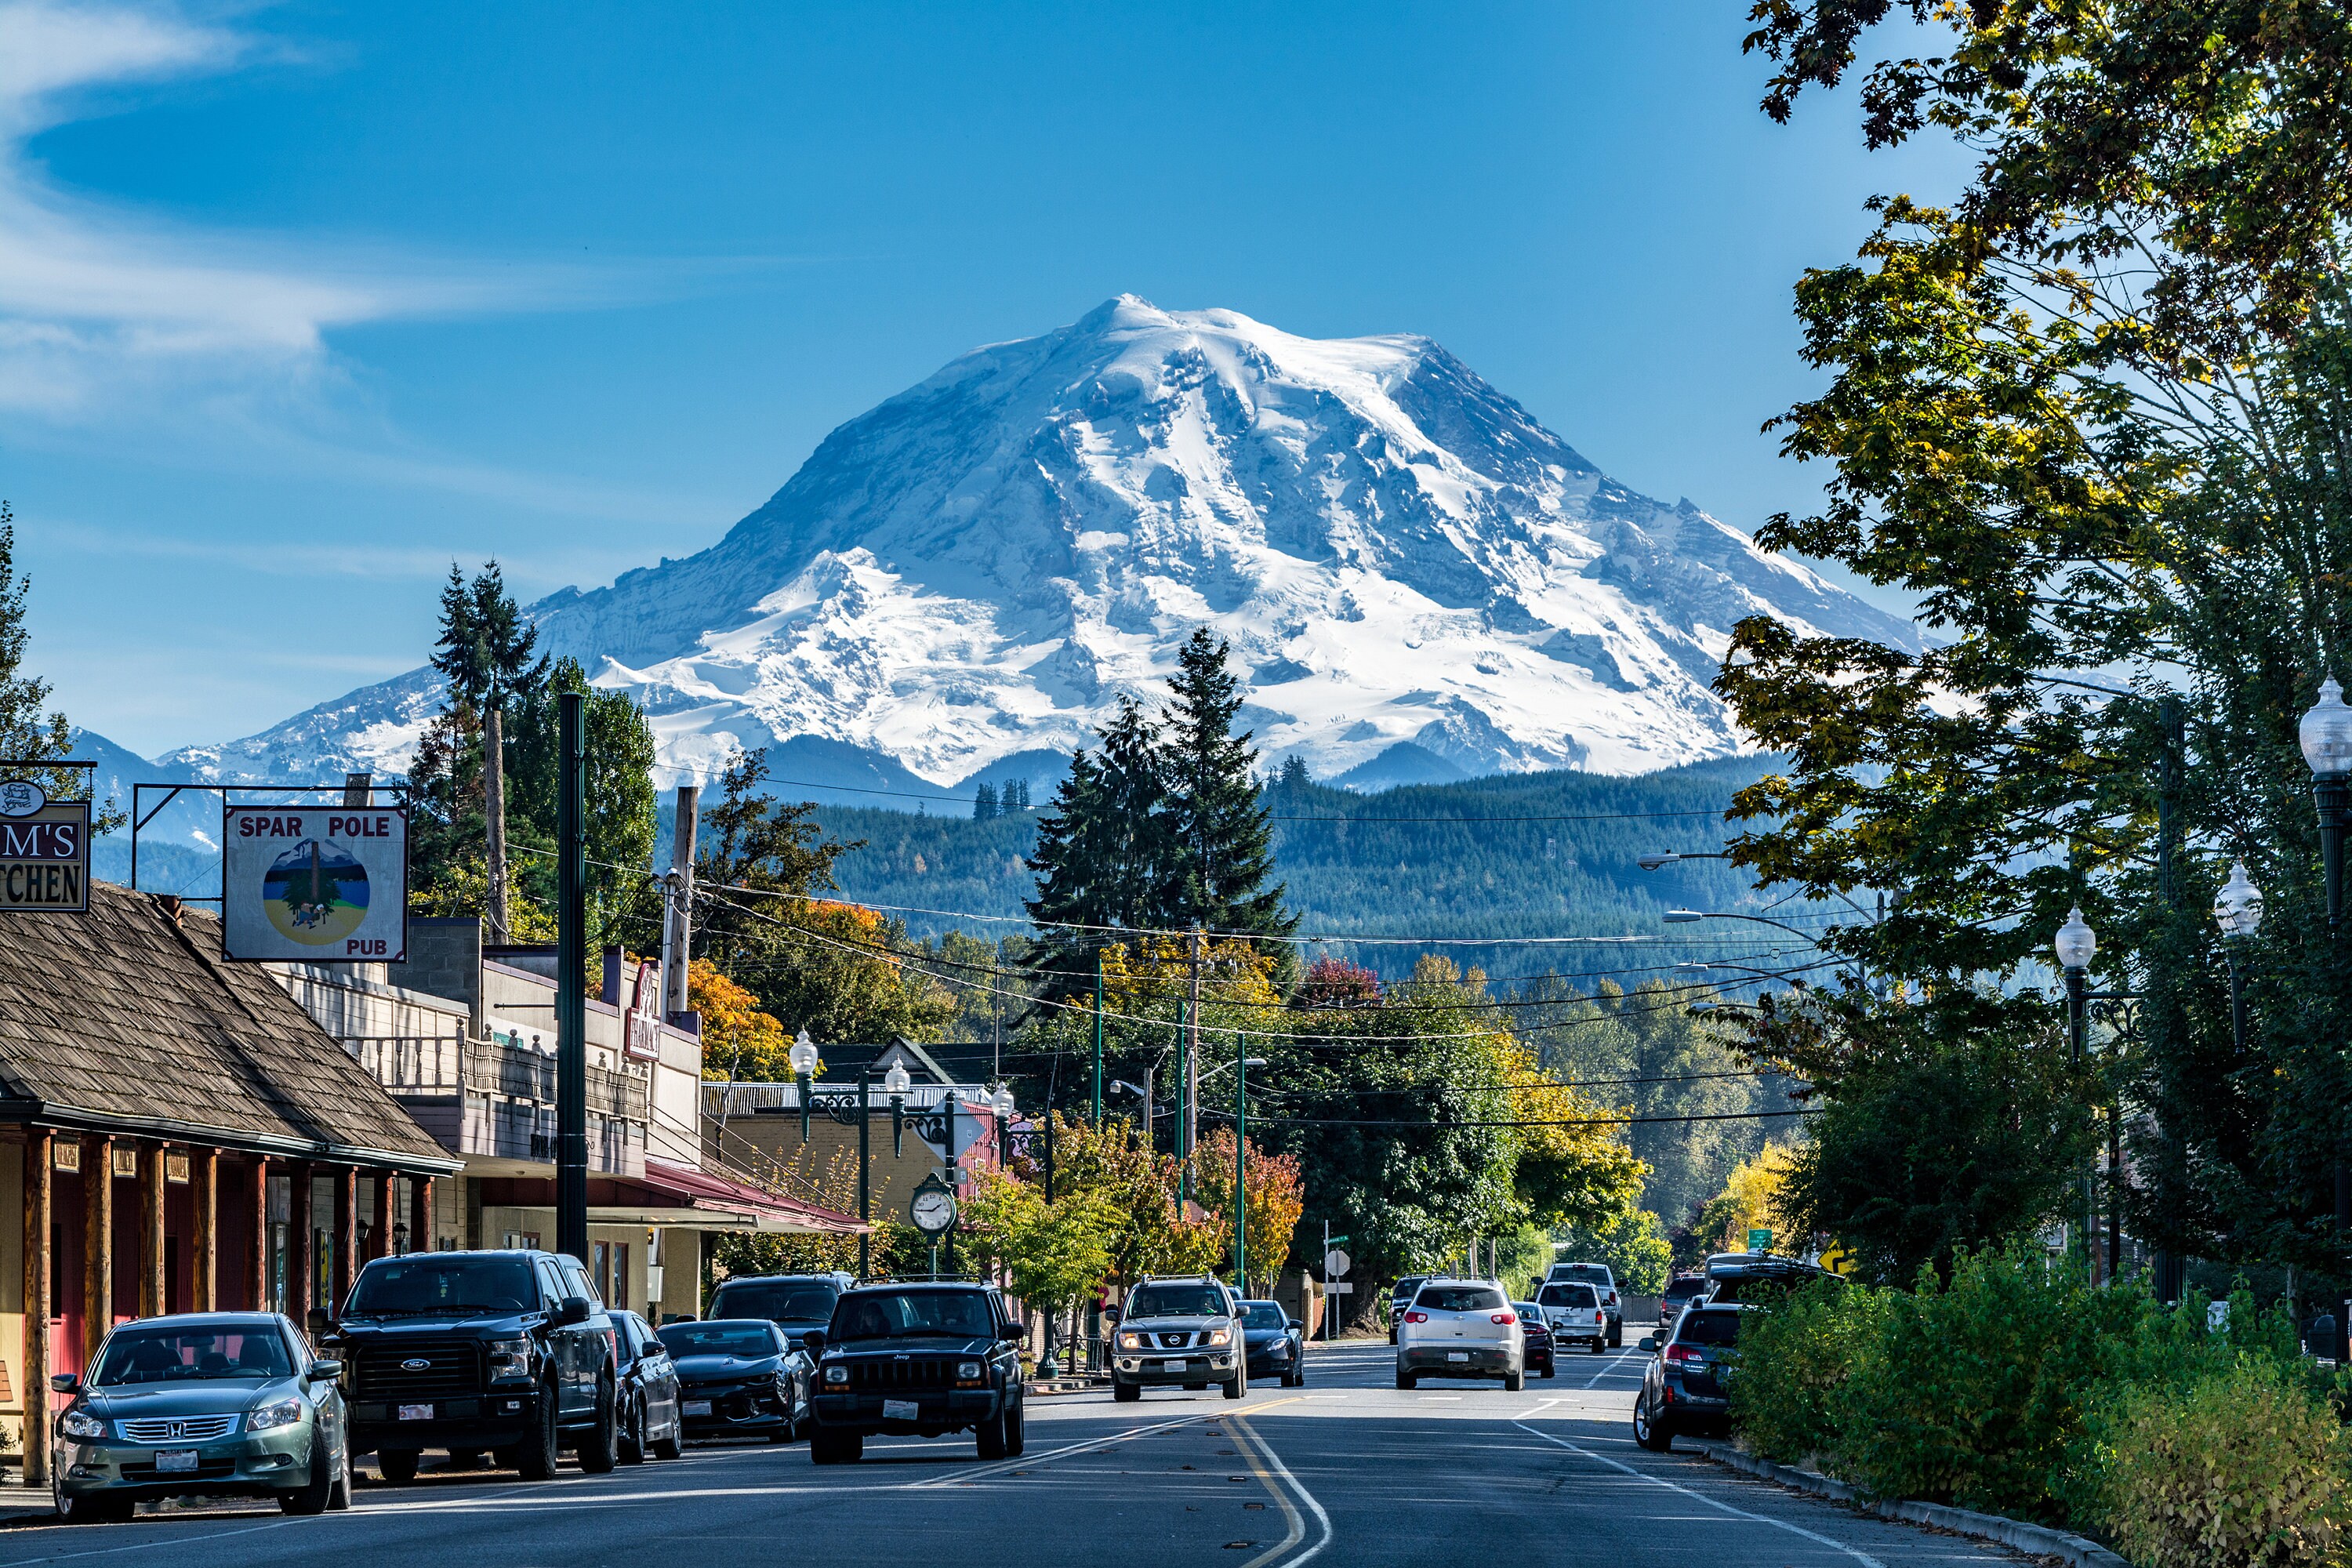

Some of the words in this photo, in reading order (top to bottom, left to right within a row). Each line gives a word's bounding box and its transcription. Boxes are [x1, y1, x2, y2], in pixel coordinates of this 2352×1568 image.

[239, 816, 303, 837] SPAR
[328, 816, 390, 837] POLE
[2, 824, 75, 857] M'S
[347, 939, 387, 955] PUB
